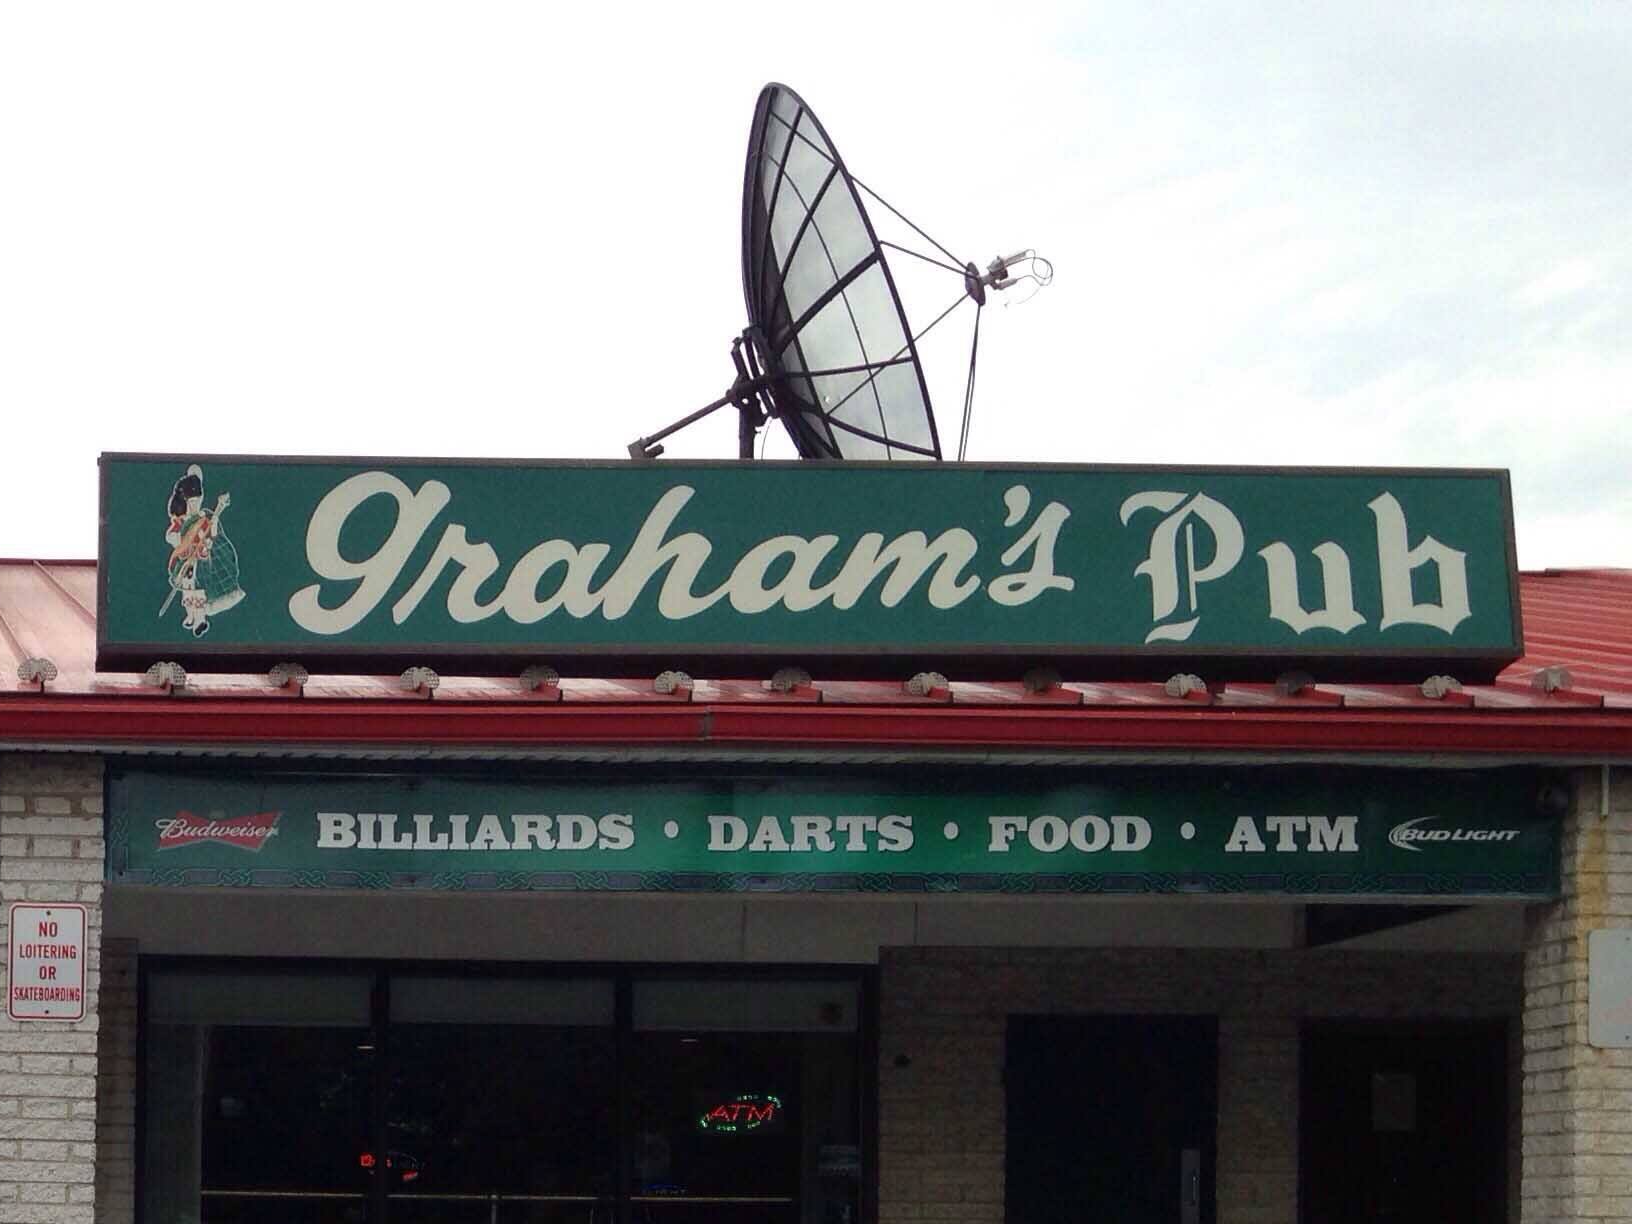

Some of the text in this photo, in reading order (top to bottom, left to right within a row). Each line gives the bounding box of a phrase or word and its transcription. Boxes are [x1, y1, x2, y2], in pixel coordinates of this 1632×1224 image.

[288, 470, 1472, 645] Graham's Pub
[154, 818, 280, 839] Budweiser
[316, 812, 1360, 852] BILLIARDS DARTS FOOD ATM
[1401, 828, 1521, 841] BUD LIGHT
[38, 921, 58, 938] NO
[18, 943, 77, 960] LOITERING
[39, 965, 57, 980] OR
[13, 986, 81, 1003] SKATEBOARDING
[705, 1103, 775, 1122] ATM
